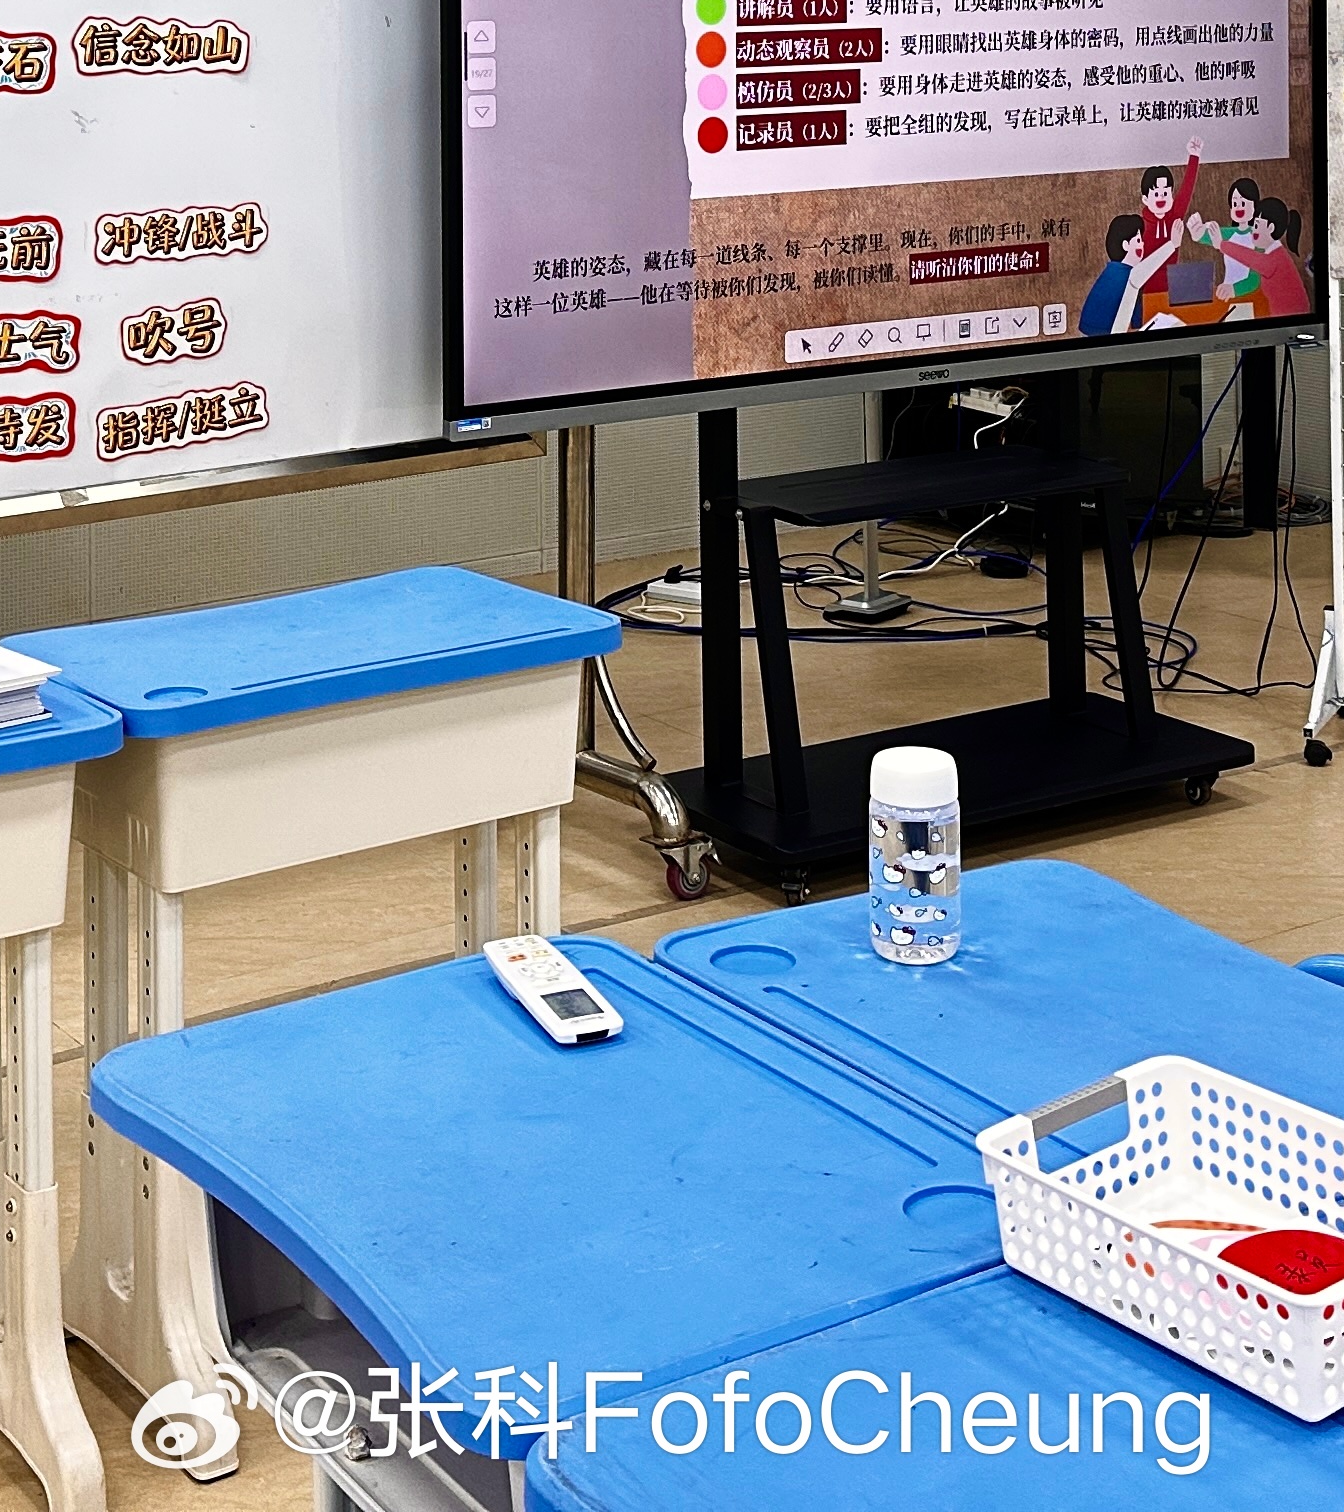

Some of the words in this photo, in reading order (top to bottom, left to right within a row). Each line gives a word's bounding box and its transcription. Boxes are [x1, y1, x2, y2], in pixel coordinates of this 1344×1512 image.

[80, 25, 243, 70] 信念如山
[102, 210, 263, 258] 冲锋/战斗
[128, 308, 220, 357] 吹号
[919, 369, 949, 381] seewo
[102, 392, 263, 453] 指挥/挺立
